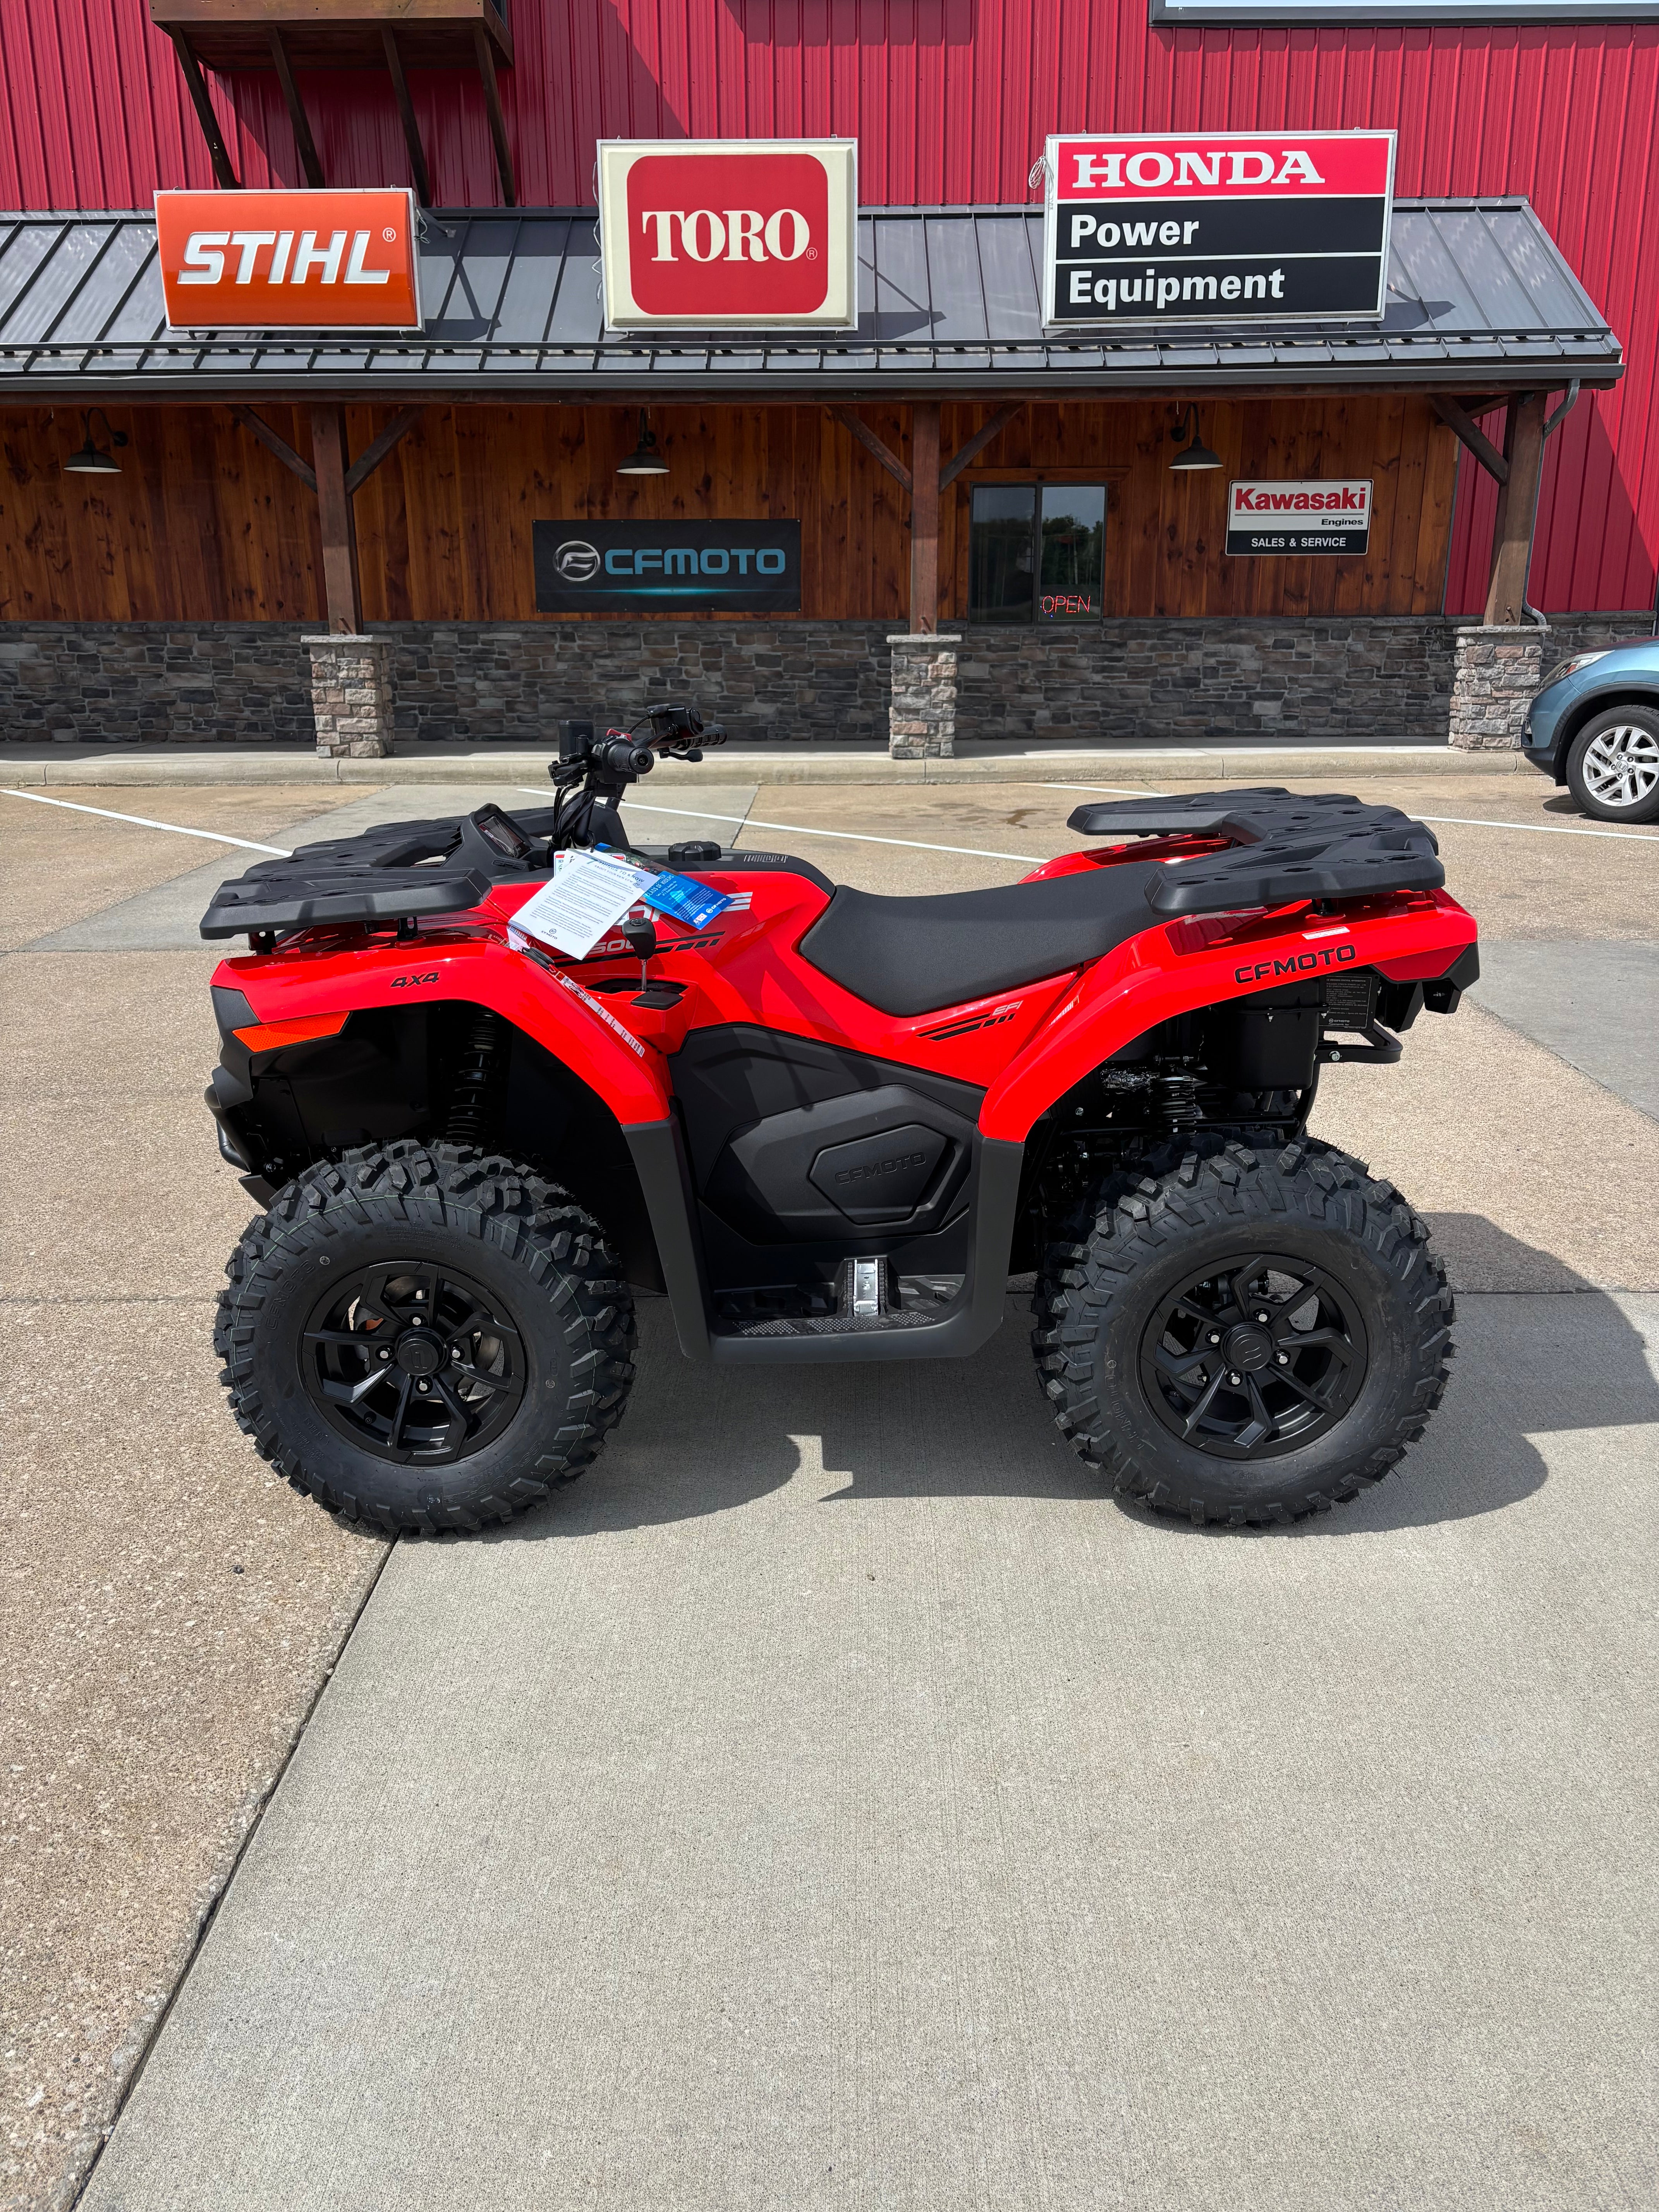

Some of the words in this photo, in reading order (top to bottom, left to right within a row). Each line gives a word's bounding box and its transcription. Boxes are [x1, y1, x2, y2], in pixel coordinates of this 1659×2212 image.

[1072, 151, 1326, 188] HONDA
[642, 208, 810, 262] TORO
[1070, 214, 1199, 248] Power
[177, 230, 390, 284] STIHL
[1069, 268, 1285, 310] Equipment
[1235, 487, 1366, 510] Kawasaki
[1321, 518, 1364, 527] Engines
[1251, 537, 1285, 547] SALES
[1289, 538, 1297, 547] &
[1300, 537, 1346, 547] SERVICE
[605, 548, 786, 575] CFMOTO
[1042, 595, 1091, 613] OPEN
[1235, 945, 1357, 984] CFMOTO
[992, 1000, 1024, 1016] EFI
[835, 1151, 927, 1185] CFMOTO
